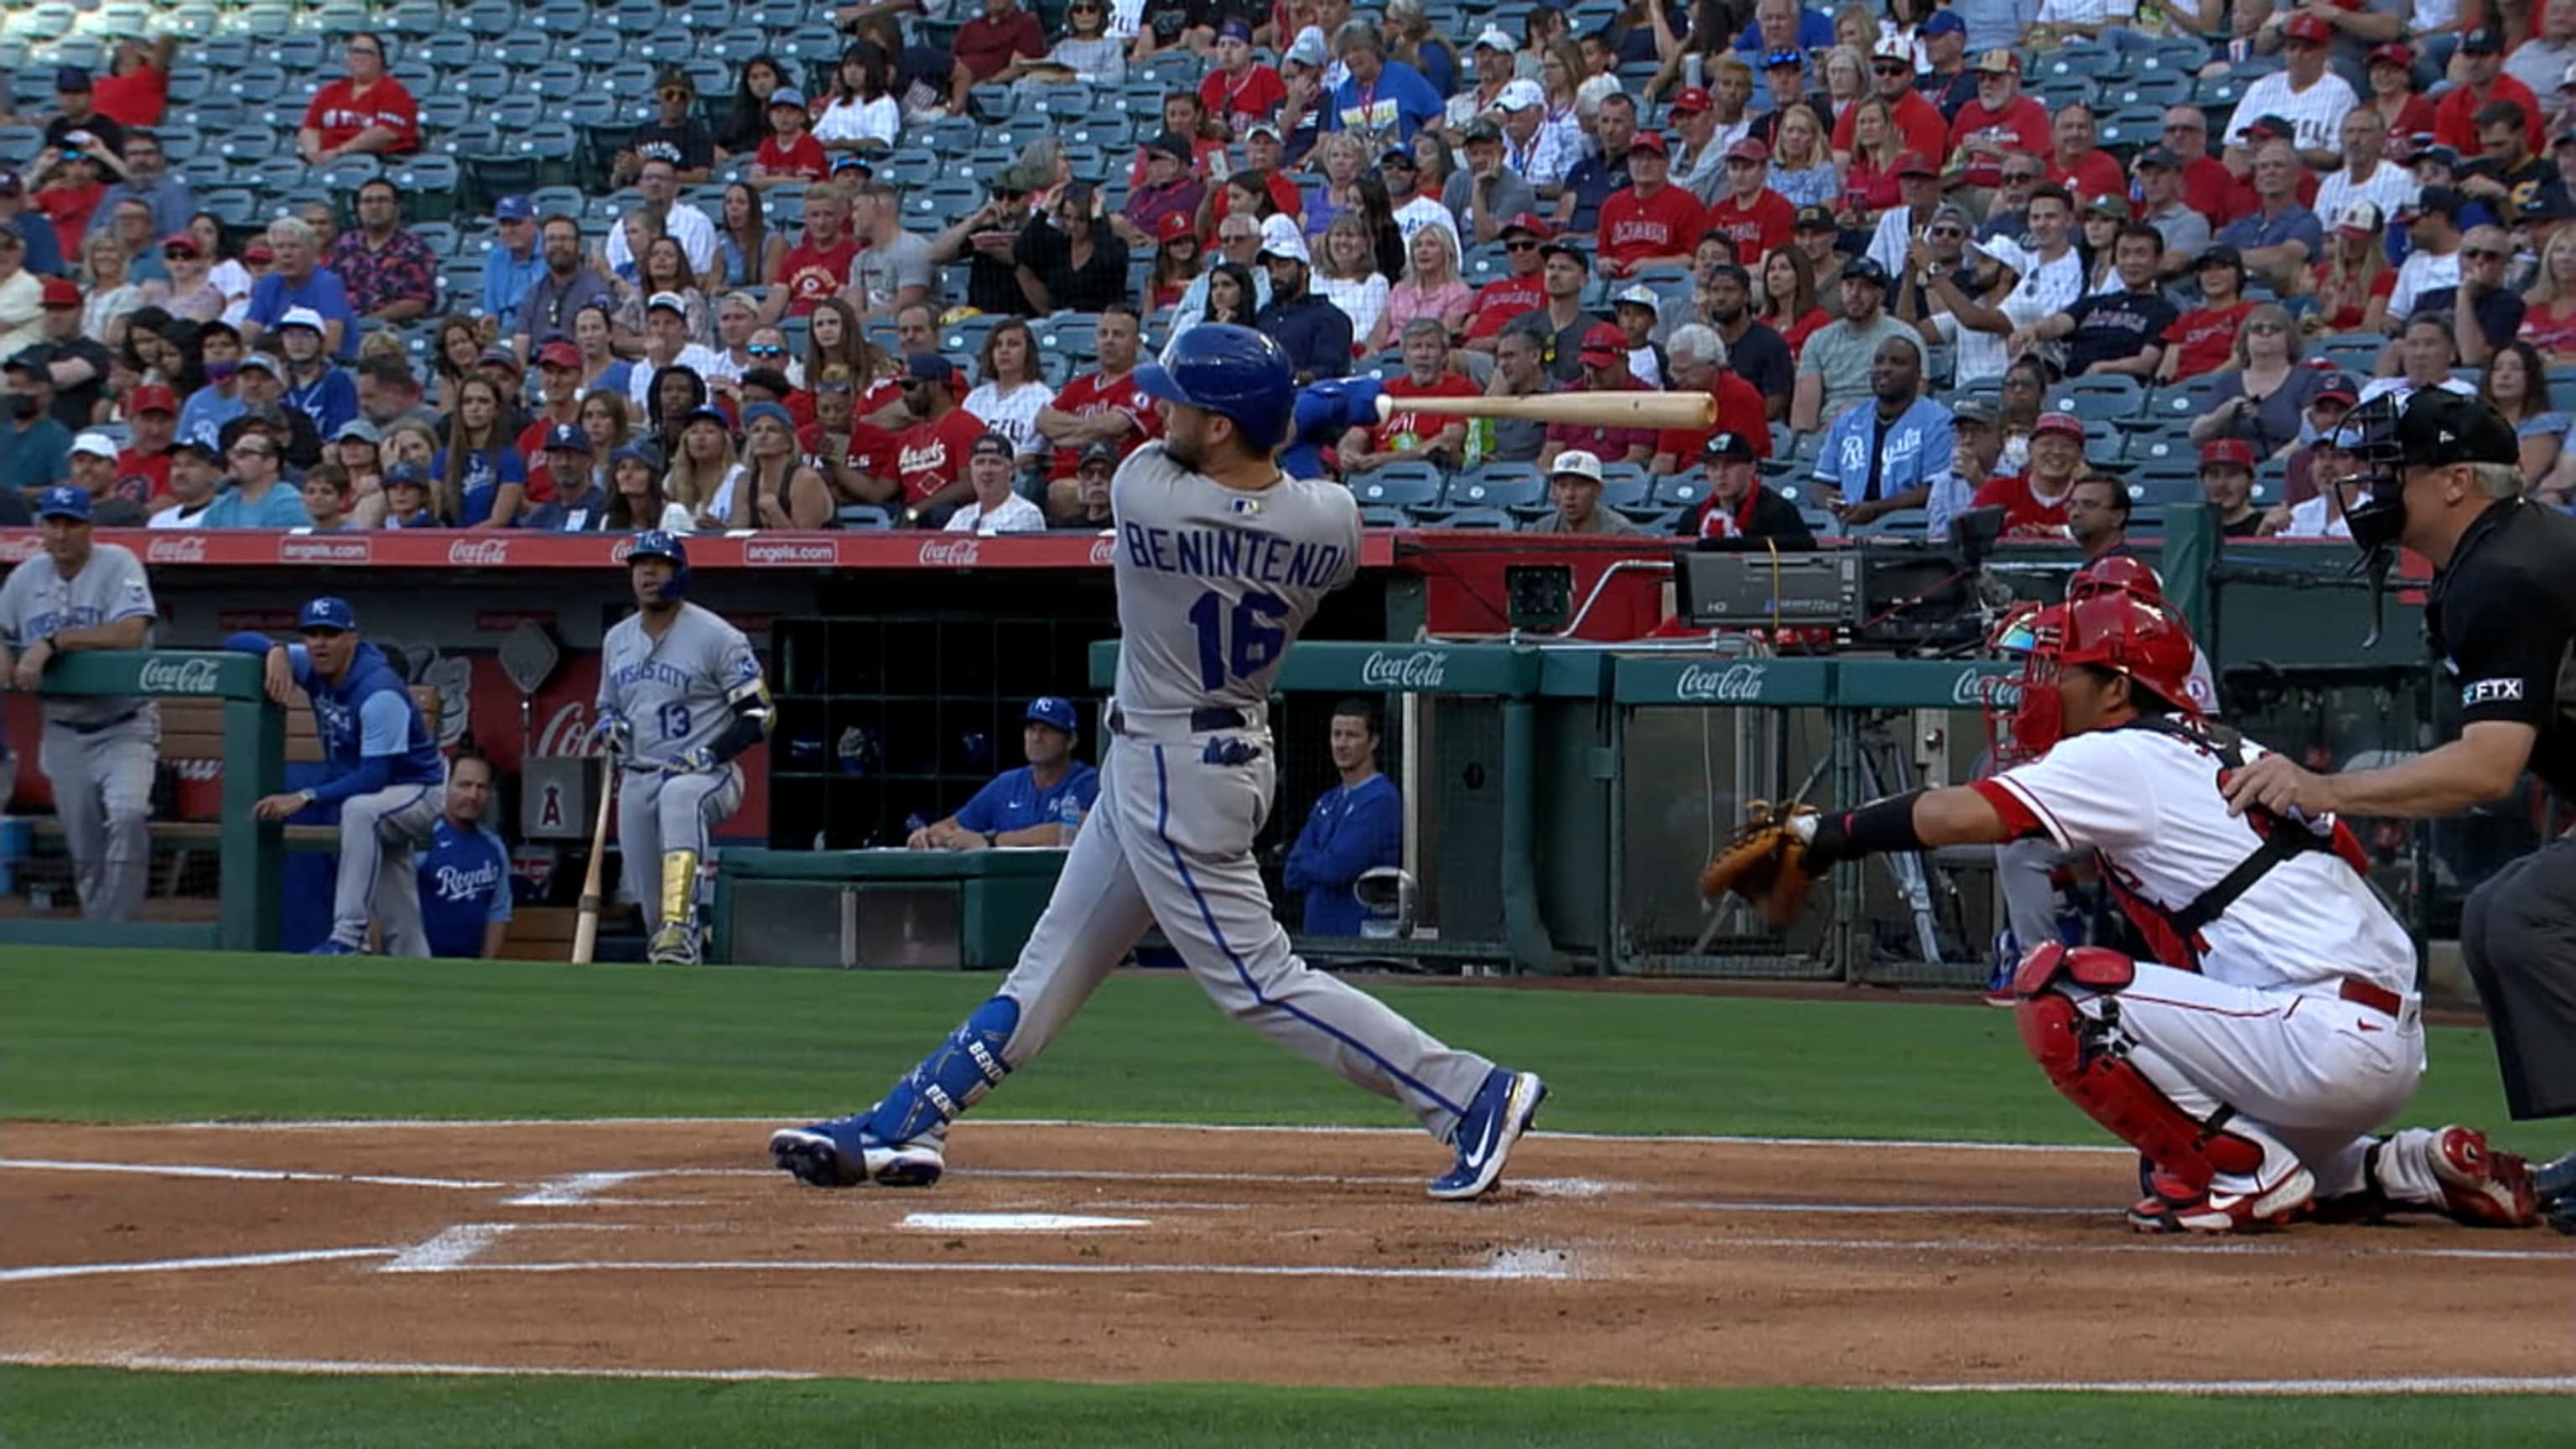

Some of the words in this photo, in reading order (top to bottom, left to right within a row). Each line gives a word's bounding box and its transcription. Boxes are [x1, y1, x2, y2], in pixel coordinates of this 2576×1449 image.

[748, 545, 833, 560] angels.com
[1188, 590, 1290, 693] 16
[2476, 680, 2521, 699] FTX
[657, 704, 692, 739] 13
